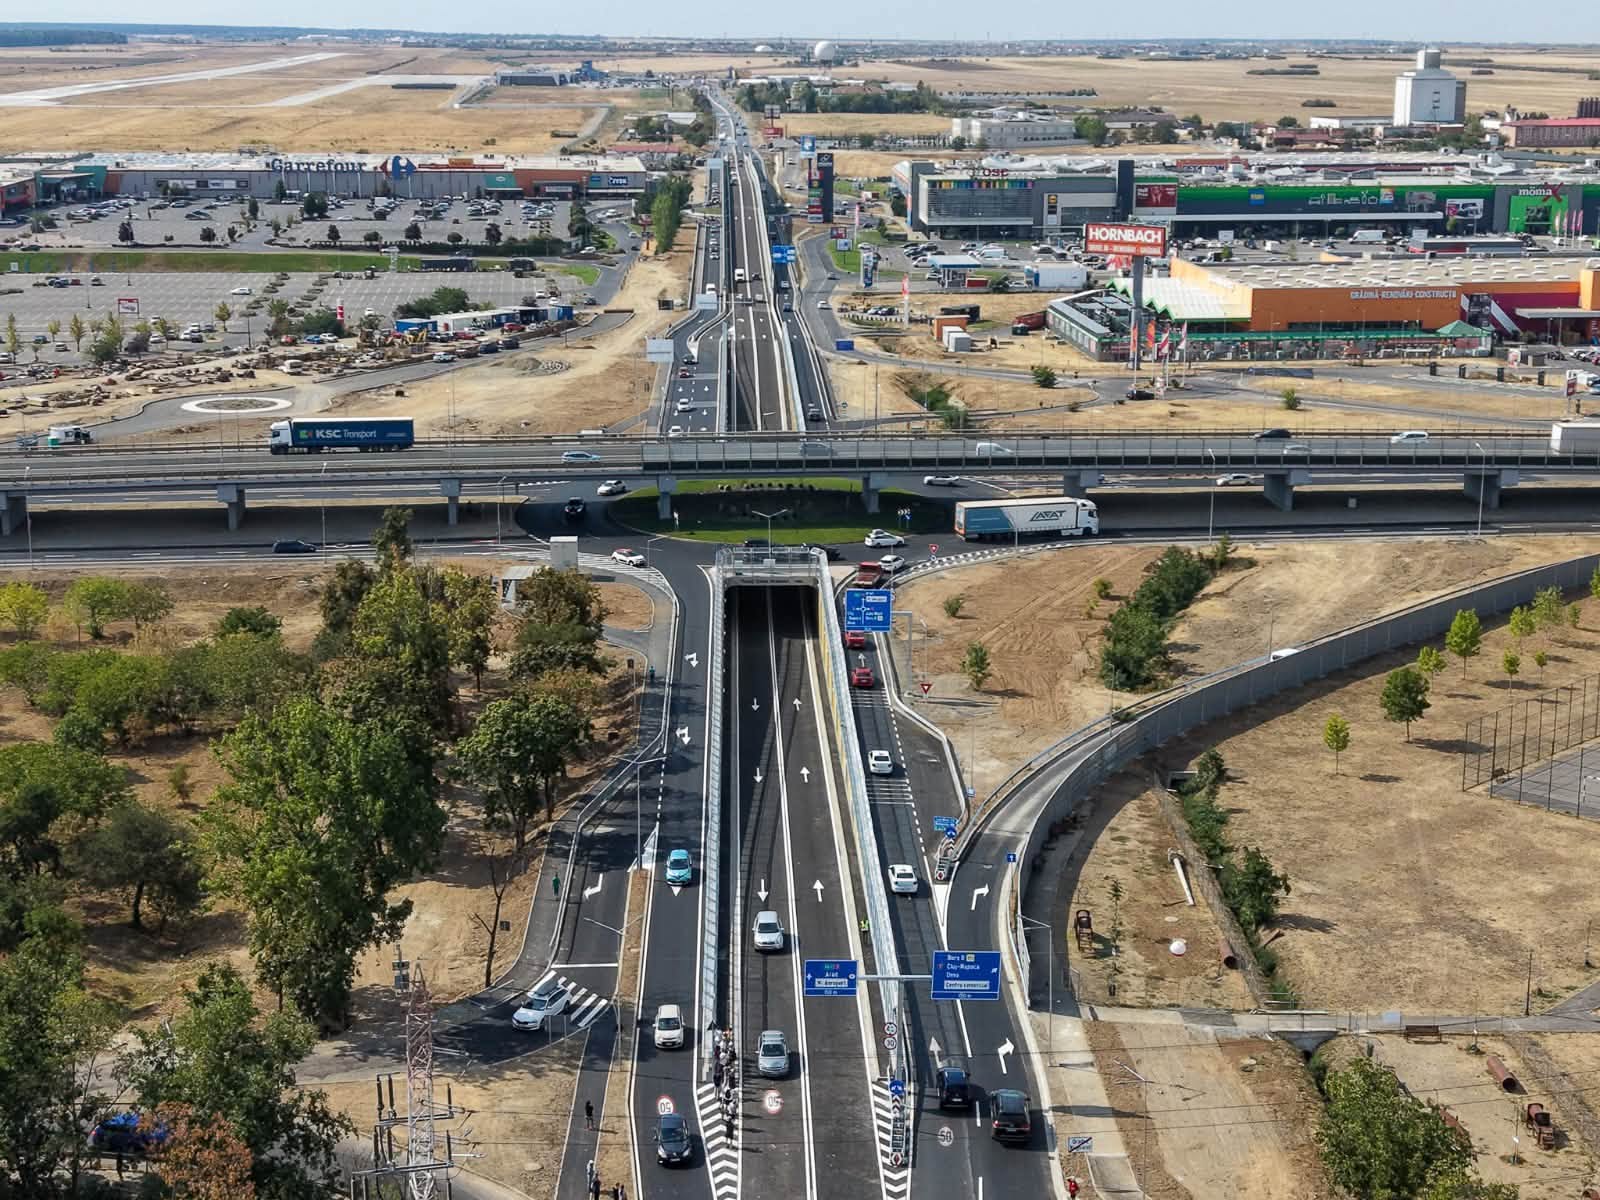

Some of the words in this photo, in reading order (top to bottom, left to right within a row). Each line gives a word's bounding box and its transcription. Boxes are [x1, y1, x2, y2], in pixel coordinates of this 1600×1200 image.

[271, 158, 367, 173] Carrefour
[1089, 227, 1162, 244] HORNBACH
[315, 429, 341, 439] KSC
[343, 428, 377, 440] Transport
